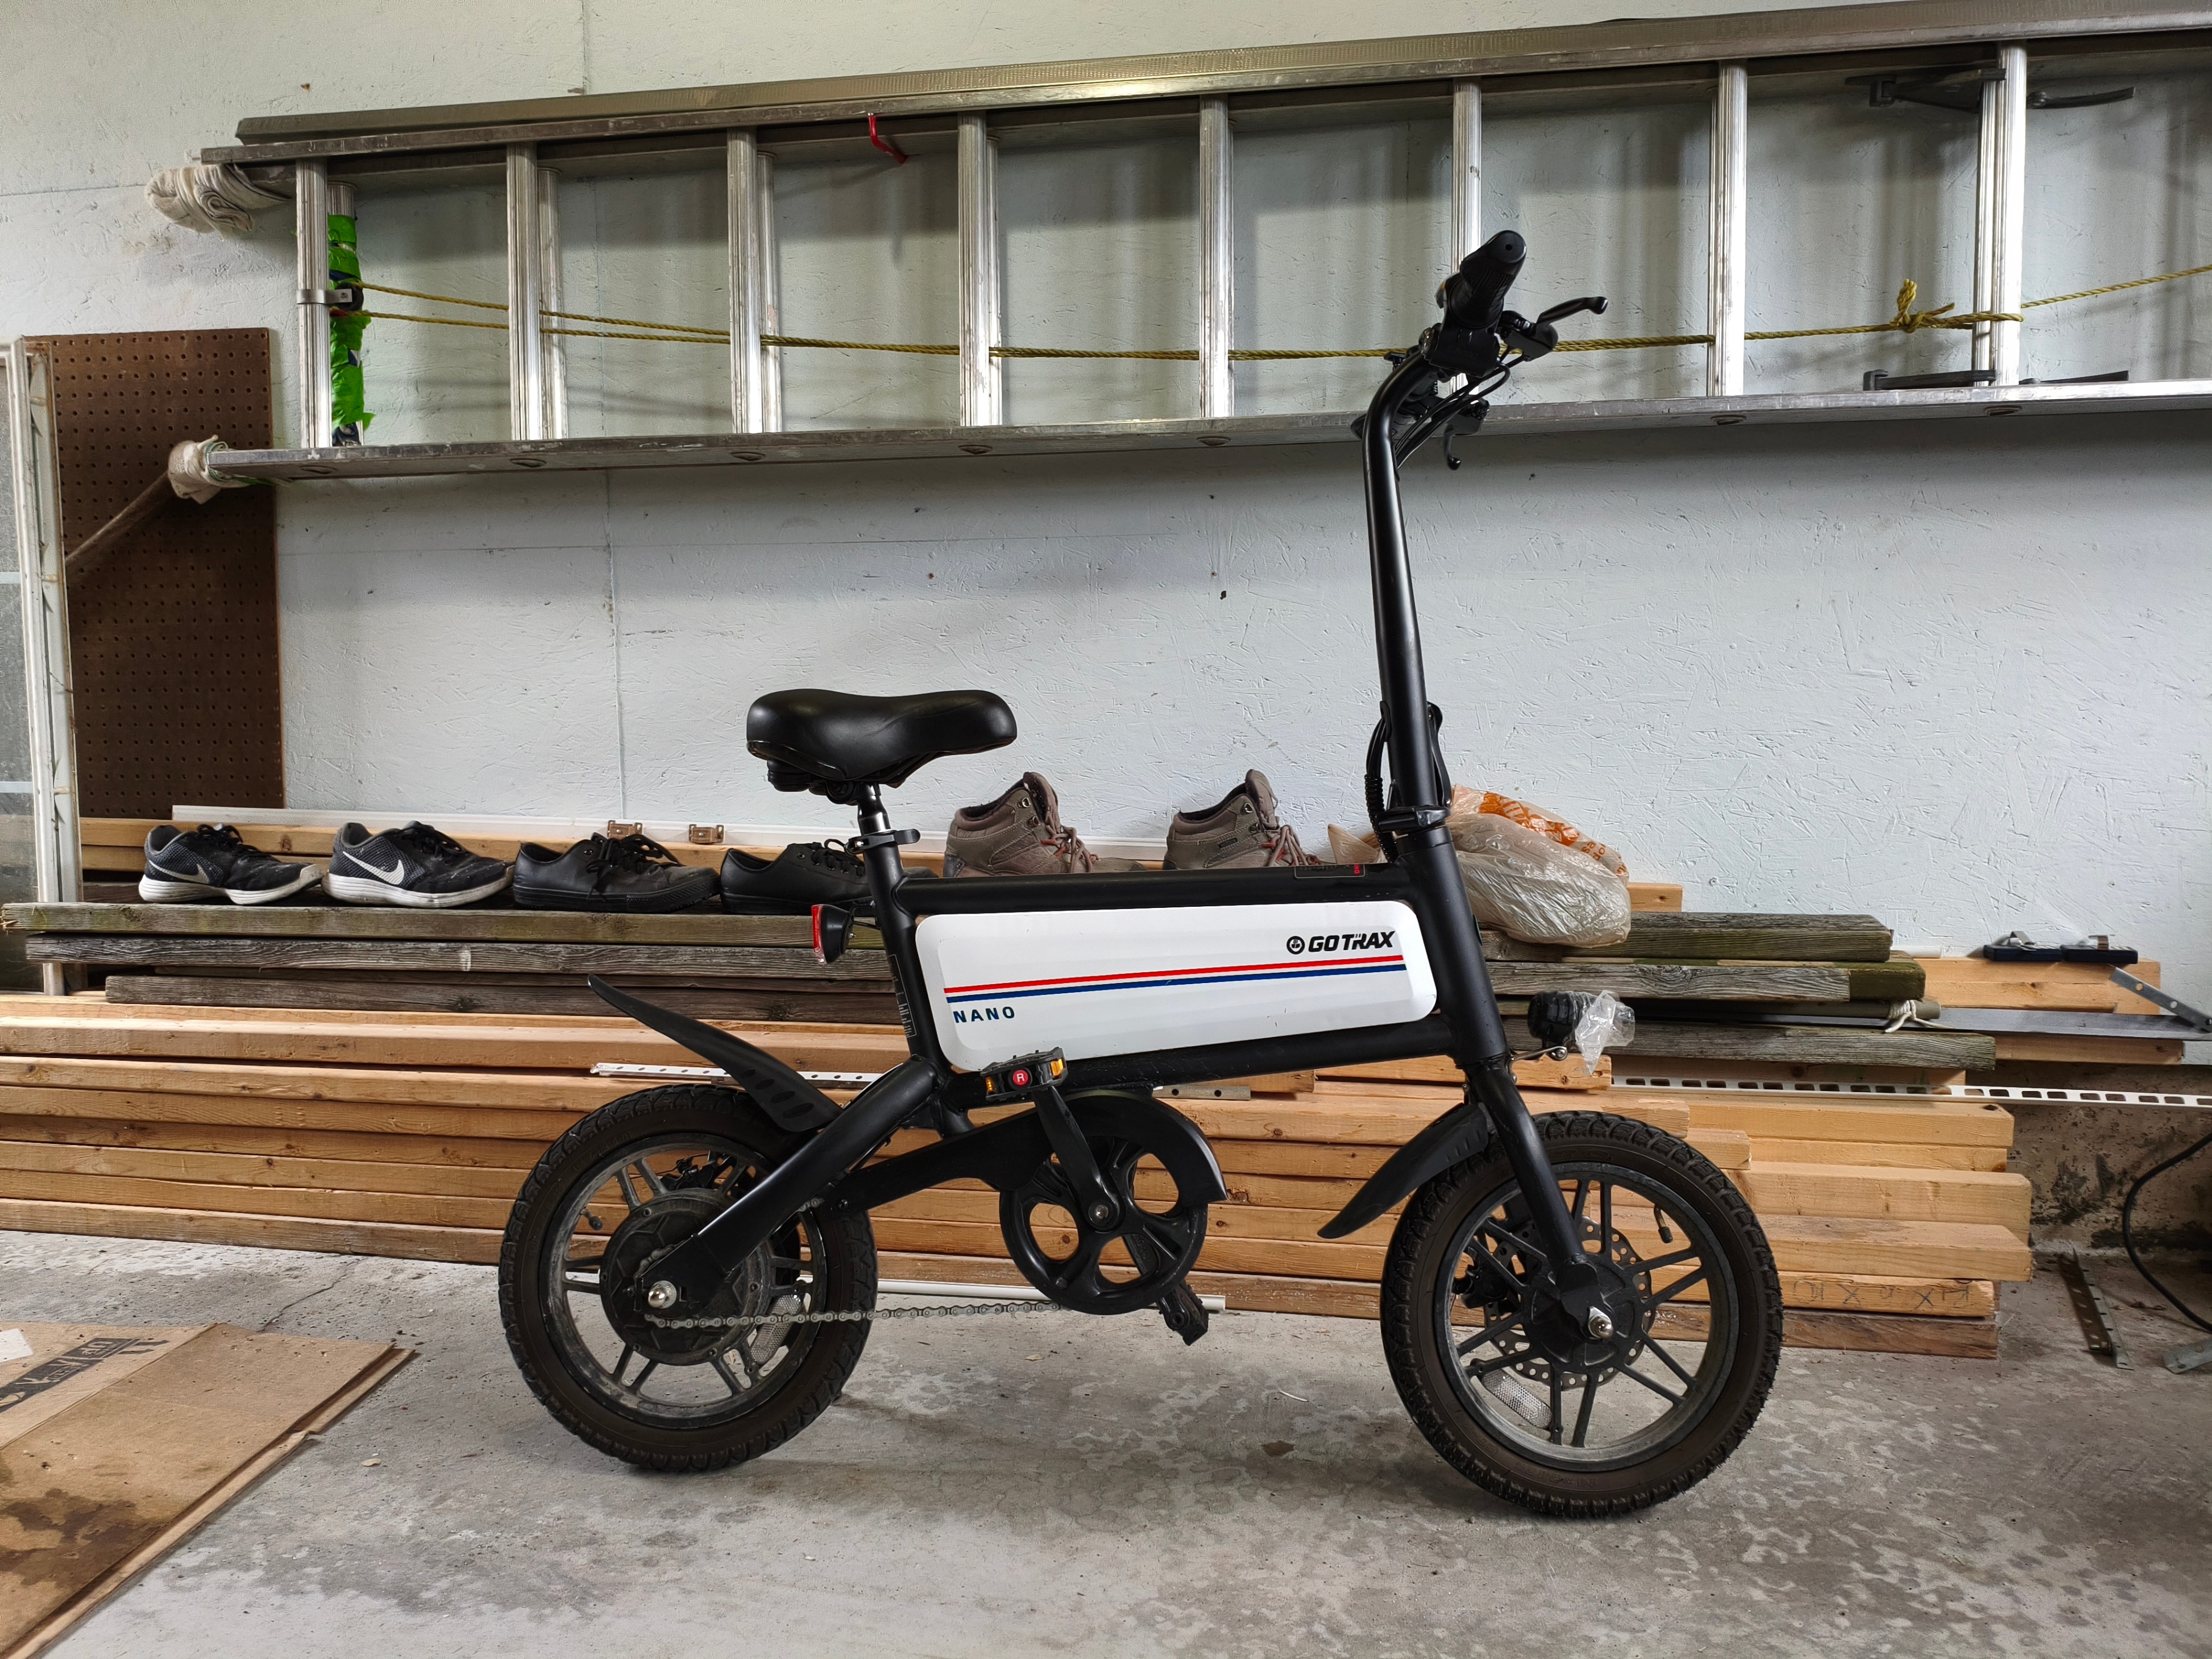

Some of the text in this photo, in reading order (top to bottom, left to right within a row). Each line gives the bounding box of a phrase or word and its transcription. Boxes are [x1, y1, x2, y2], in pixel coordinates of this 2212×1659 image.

[1308, 930, 1396, 952] GOTRAX
[953, 1006, 1015, 1023] NANO
[1016, 1073, 1025, 1083] R
